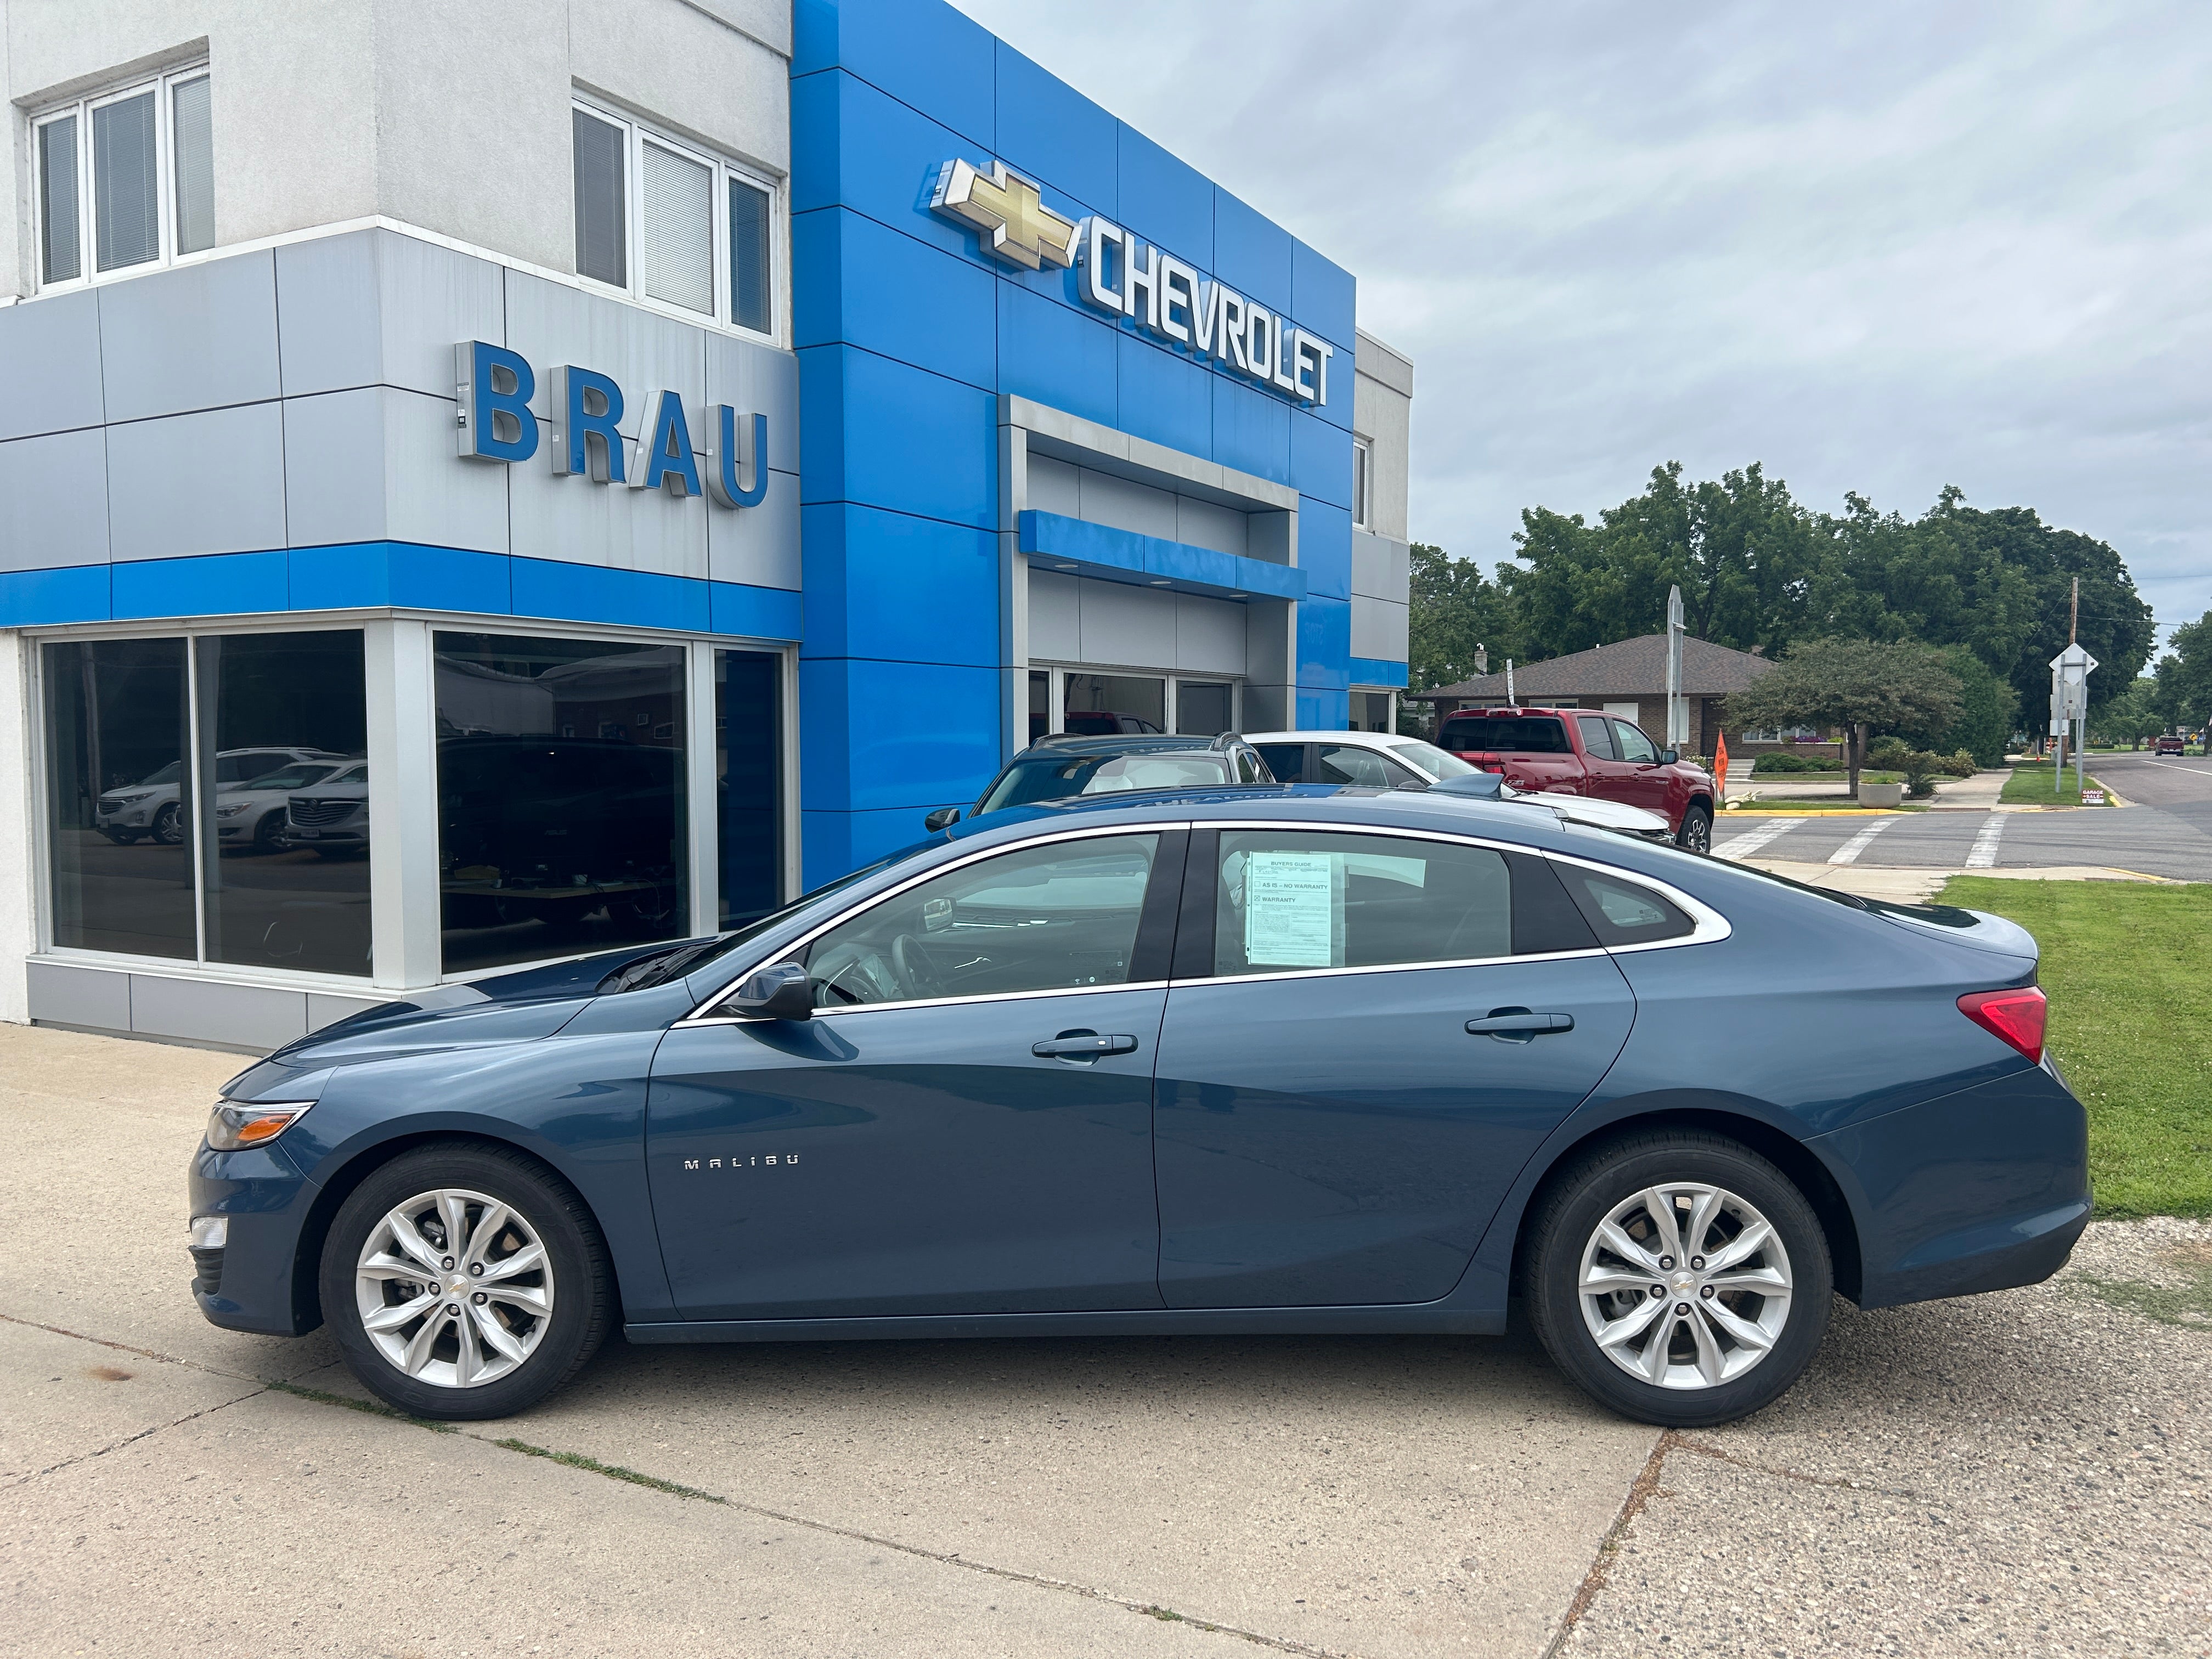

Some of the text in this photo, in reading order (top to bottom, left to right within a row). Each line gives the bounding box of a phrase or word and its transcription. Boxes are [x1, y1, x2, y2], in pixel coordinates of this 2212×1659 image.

[1086, 216, 1334, 407] CHEVROLET
[466, 340, 768, 509] BRAU
[684, 1154, 799, 1170] MALIBU
